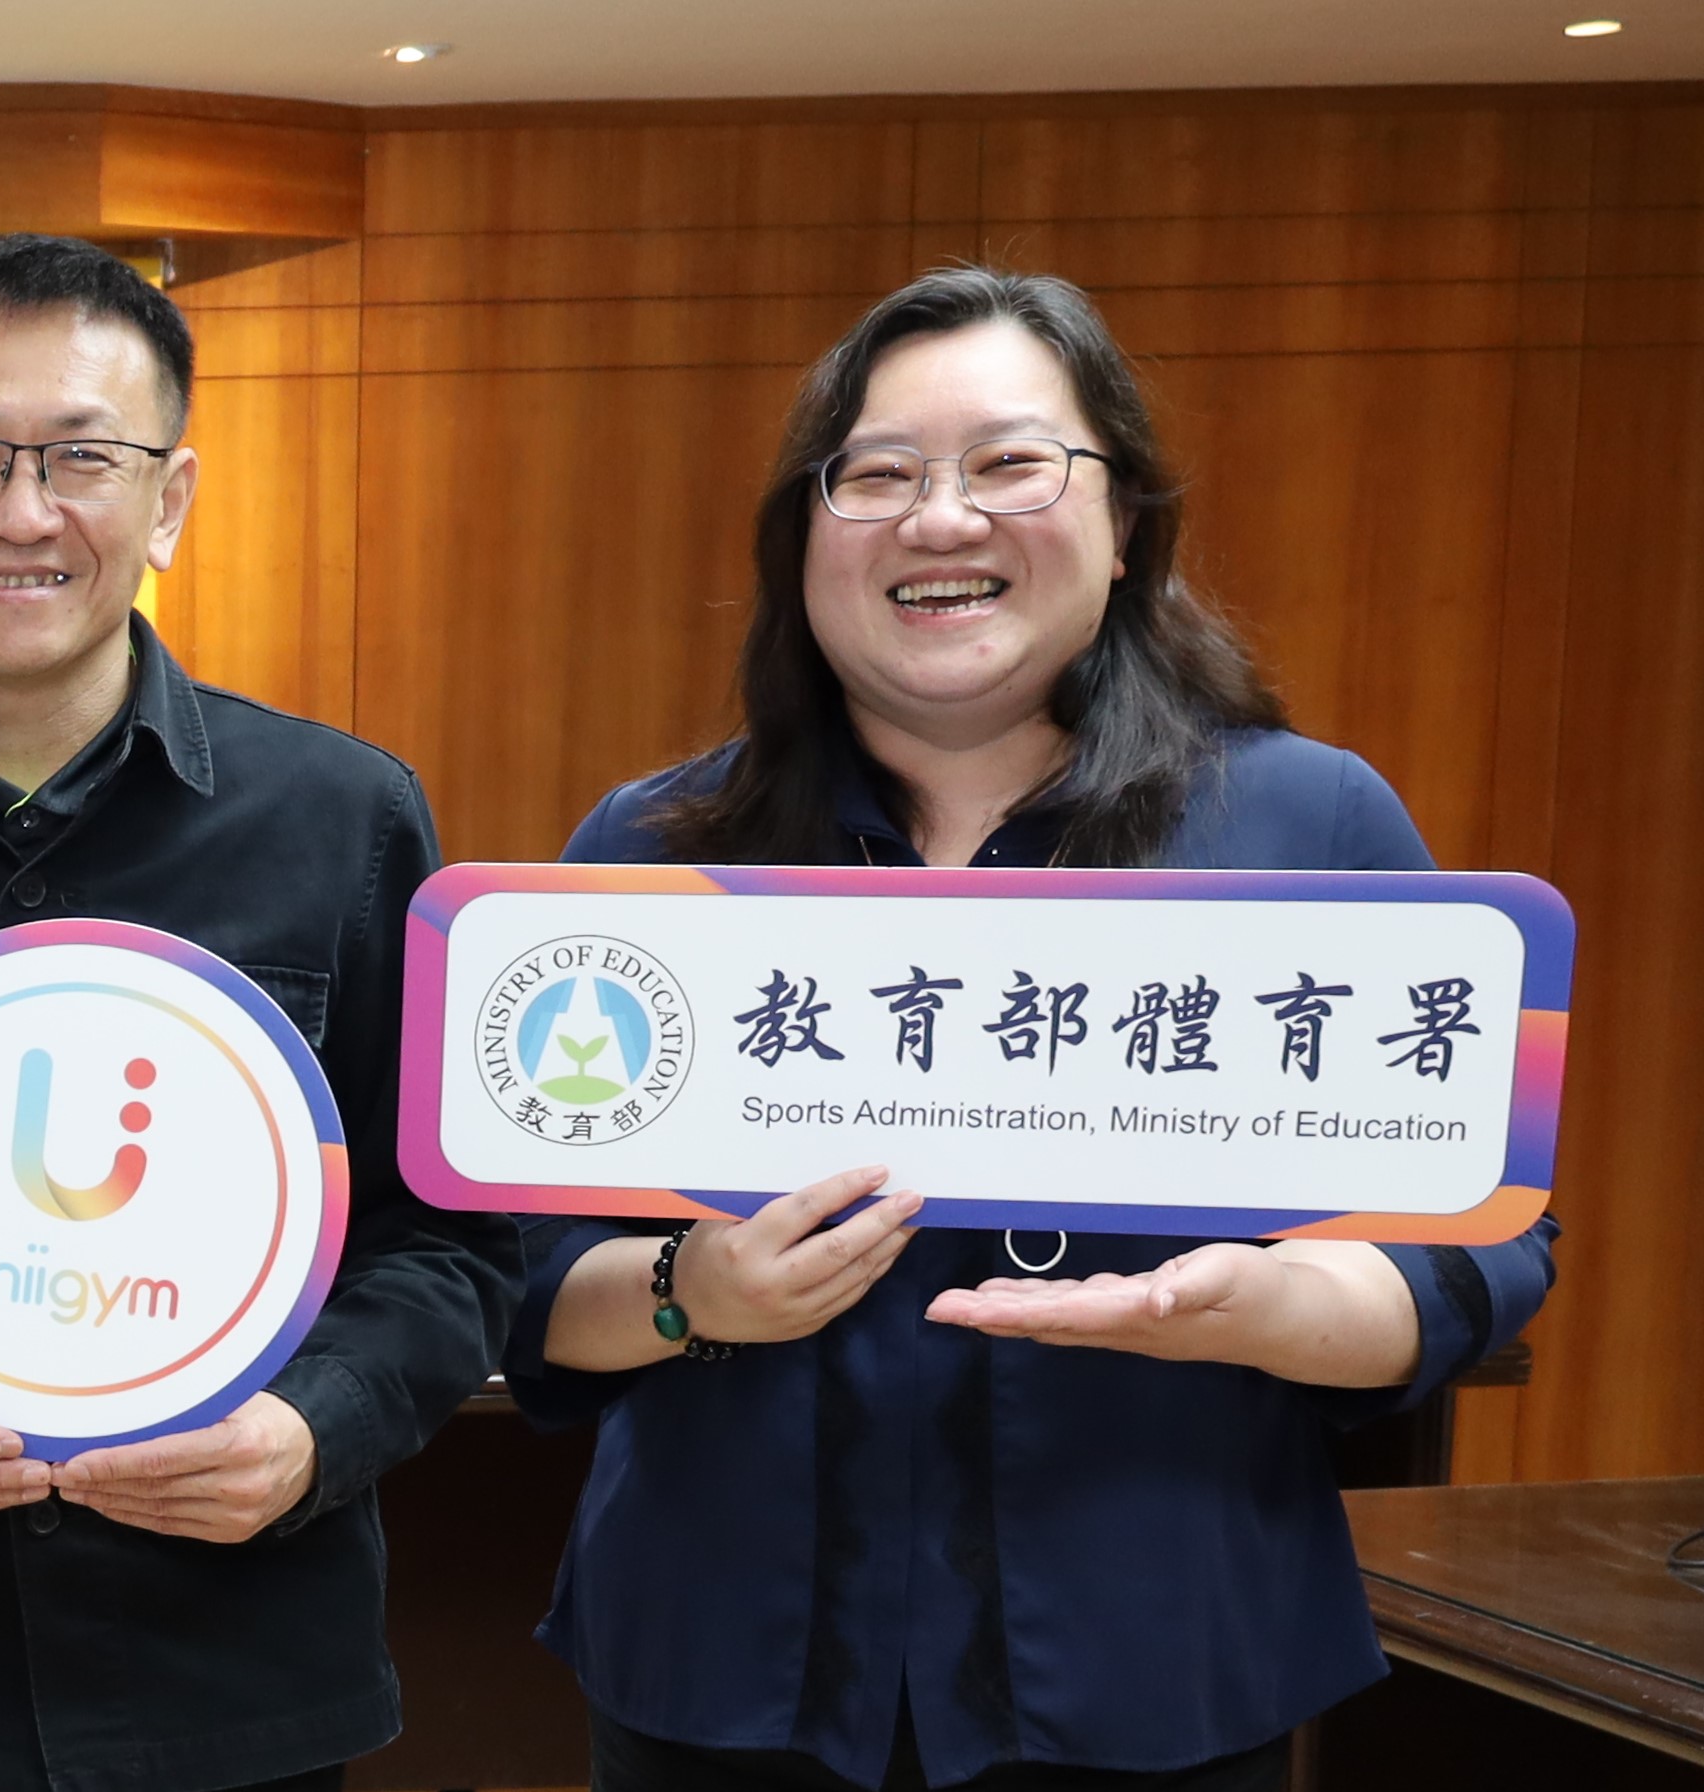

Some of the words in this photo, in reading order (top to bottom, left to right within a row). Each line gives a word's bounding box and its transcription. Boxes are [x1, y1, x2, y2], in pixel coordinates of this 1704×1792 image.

[484, 956, 547, 1095] MINISTRY
[552, 944, 593, 970] OF
[600, 947, 684, 1102] EDUCATION
[732, 964, 1483, 1084] 教育部體育署
[515, 1096, 644, 1141] 教育部
[741, 1095, 845, 1129] Sports
[852, 1099, 1096, 1137] Administration,
[1109, 1105, 1240, 1142] Ministry
[1251, 1109, 1286, 1137] of
[1294, 1110, 1467, 1142] Education
